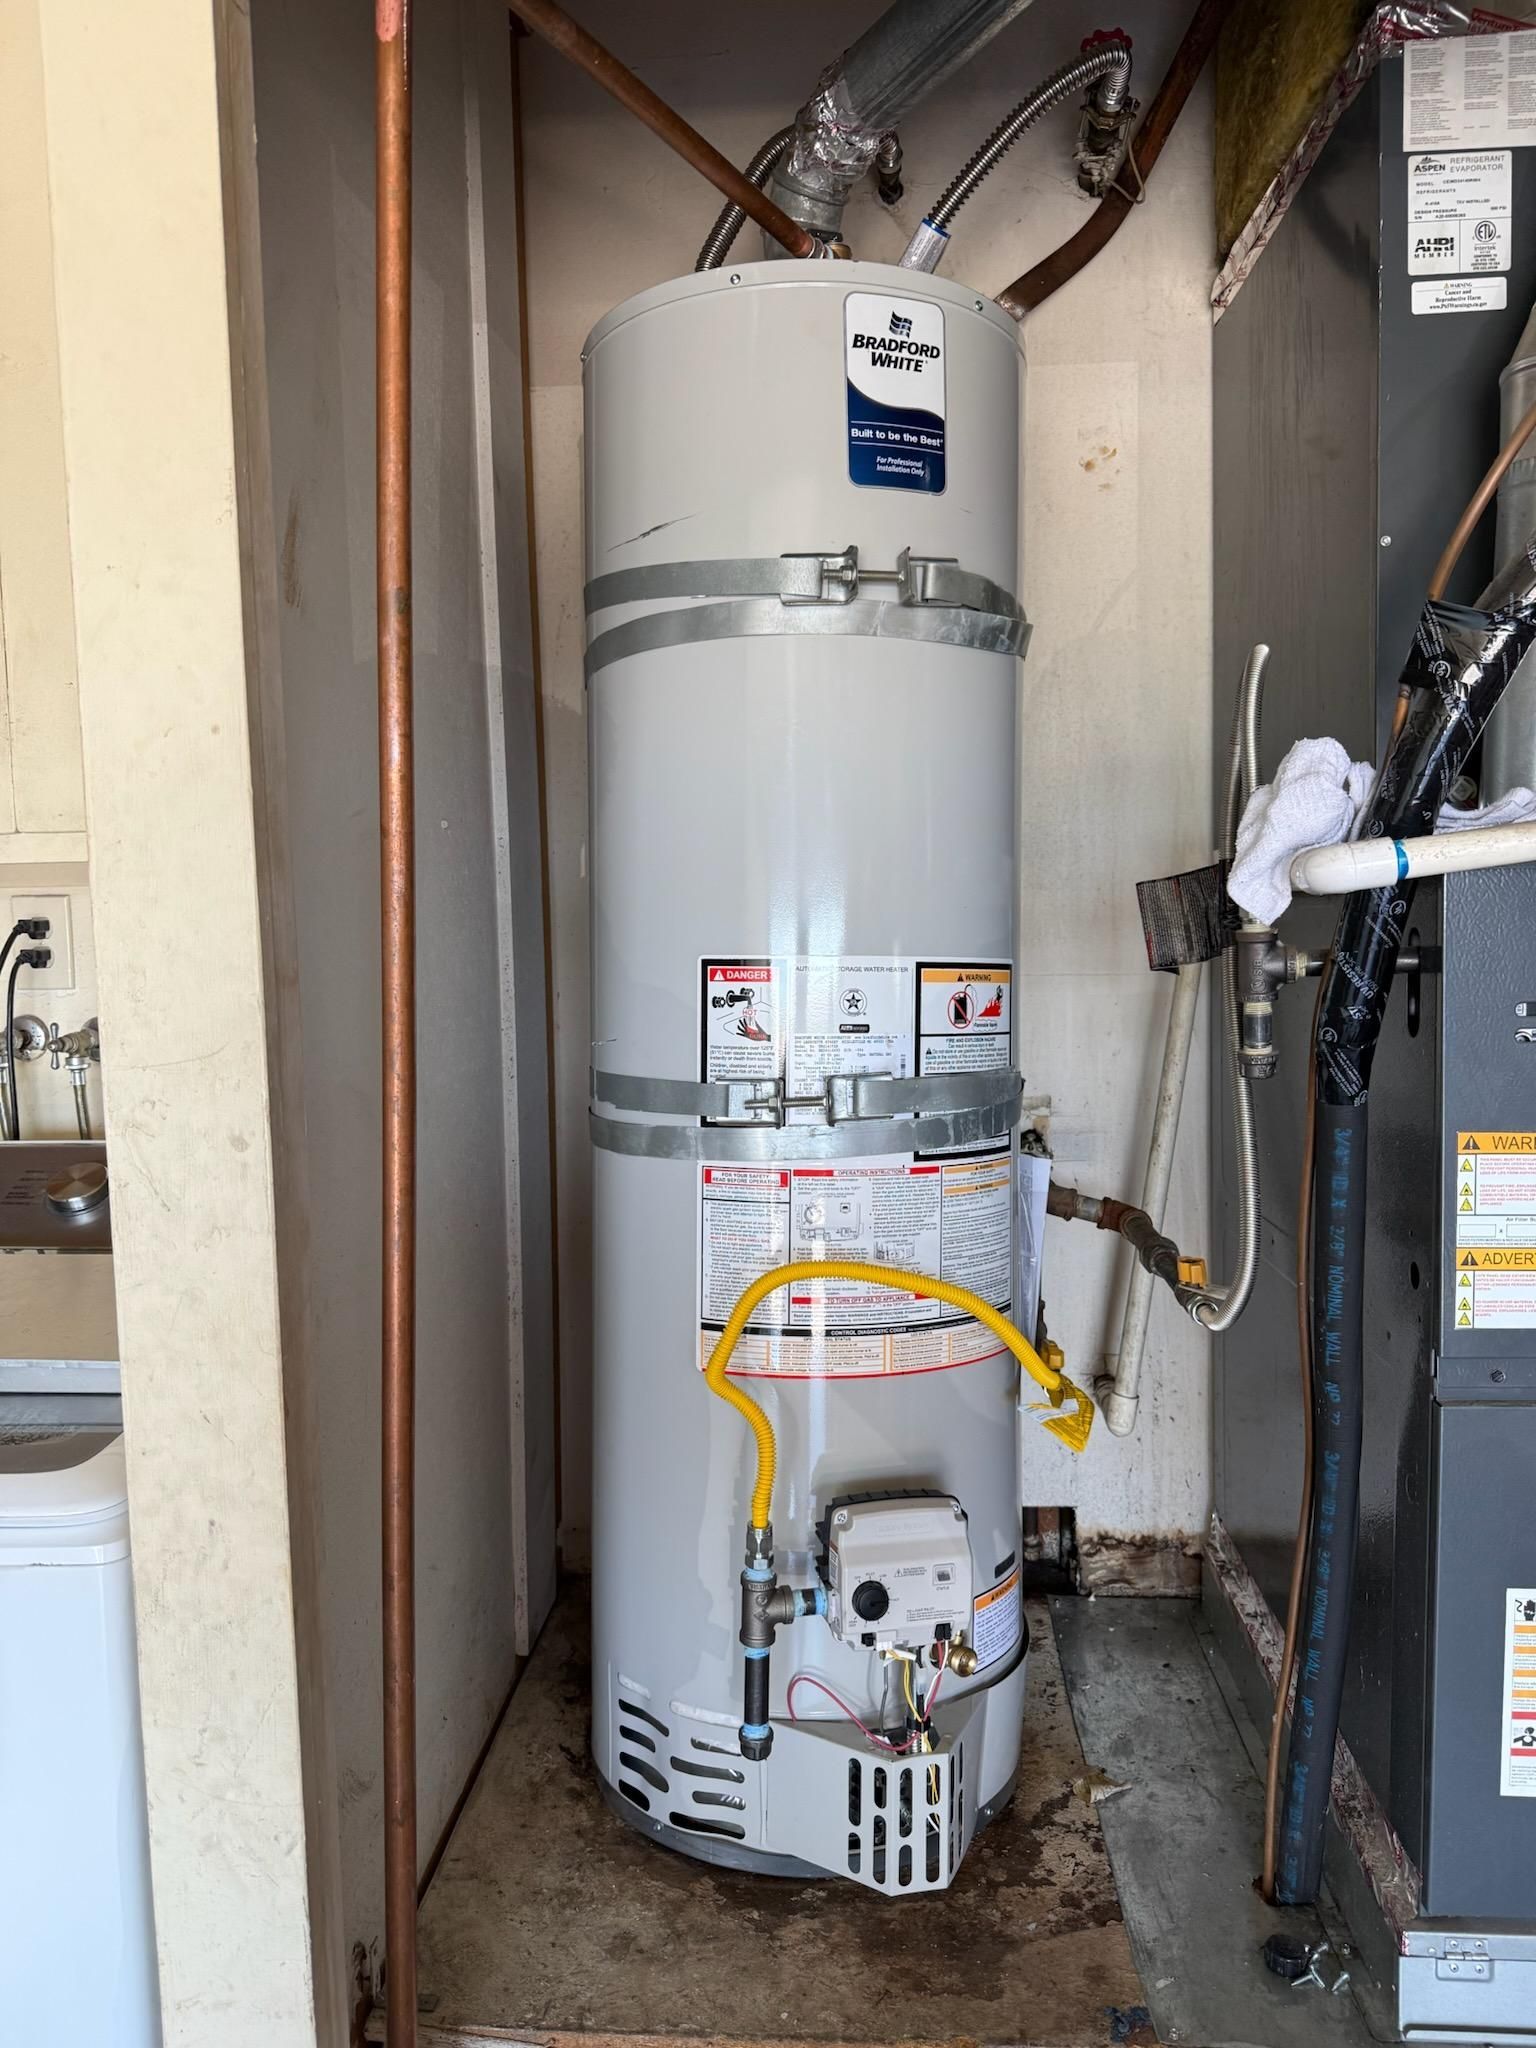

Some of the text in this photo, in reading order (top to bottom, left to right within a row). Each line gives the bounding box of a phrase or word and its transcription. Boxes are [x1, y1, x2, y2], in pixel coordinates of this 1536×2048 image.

[1450, 154, 1505, 164] REFRIGERANT
[1414, 164, 1446, 173] ASPEN
[1450, 164, 1504, 173] EVAPORATOR
[1474, 244, 1497, 252] Intertek
[852, 334, 941, 359] BRADFORD
[870, 352, 923, 373] WHITE
[851, 428, 874, 440] Built
[876, 430, 886, 440] to
[888, 430, 901, 441] be
[903, 432, 918, 444] the
[876, 456, 923, 468] For Professional
[876, 464, 926, 477] Installation Only
[726, 971, 768, 980] DANGER
[965, 974, 992, 982] WARNING
[1360, 984, 1375, 1000] UV
[1492, 1136, 1536, 1150] WAR
[1326, 1264, 1343, 1321] NOMINAL
[1325, 1330, 1342, 1367] WALL
[1308, 1585, 1331, 1640] NOMINAL
[1303, 1648, 1322, 1682] WALL
